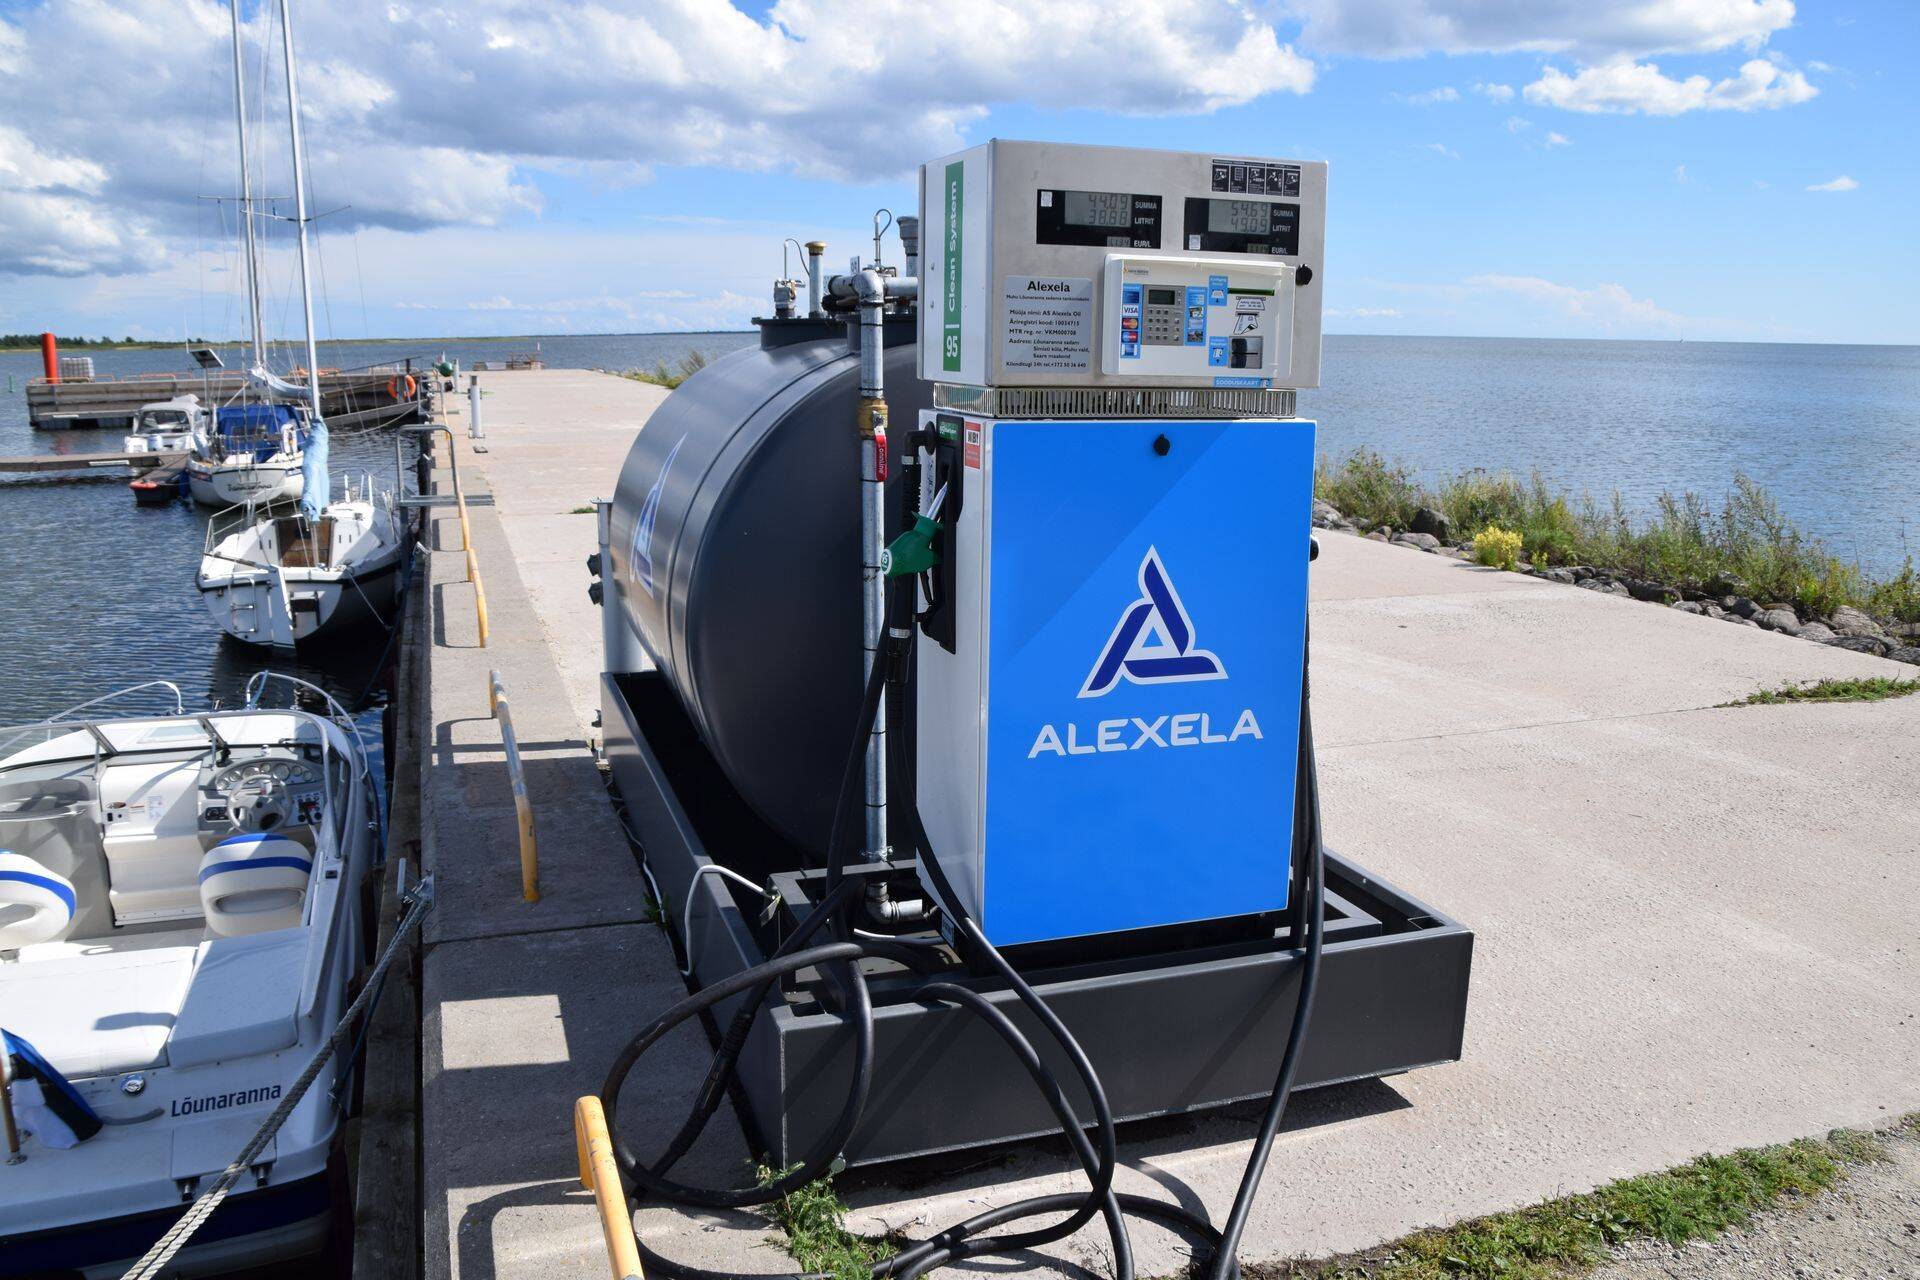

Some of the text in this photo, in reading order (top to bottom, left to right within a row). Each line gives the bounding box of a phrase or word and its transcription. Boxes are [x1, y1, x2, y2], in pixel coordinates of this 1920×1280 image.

[1134, 201, 1158, 210] SUMMA
[949, 180, 958, 252] System
[1273, 209, 1294, 217] SUMMA
[1134, 217, 1155, 225] LIITRIT
[1133, 239, 1152, 248] EUR/L
[1271, 246, 1288, 254] EUR/L
[1027, 281, 1071, 292] Alexela
[1123, 306, 1139, 314] VISA
[1009, 318, 1038, 326] Äriregistri
[946, 335, 958, 358] 95
[1027, 708, 1264, 760] ALEXELA
[171, 1084, 282, 1118] Lõunaranna
